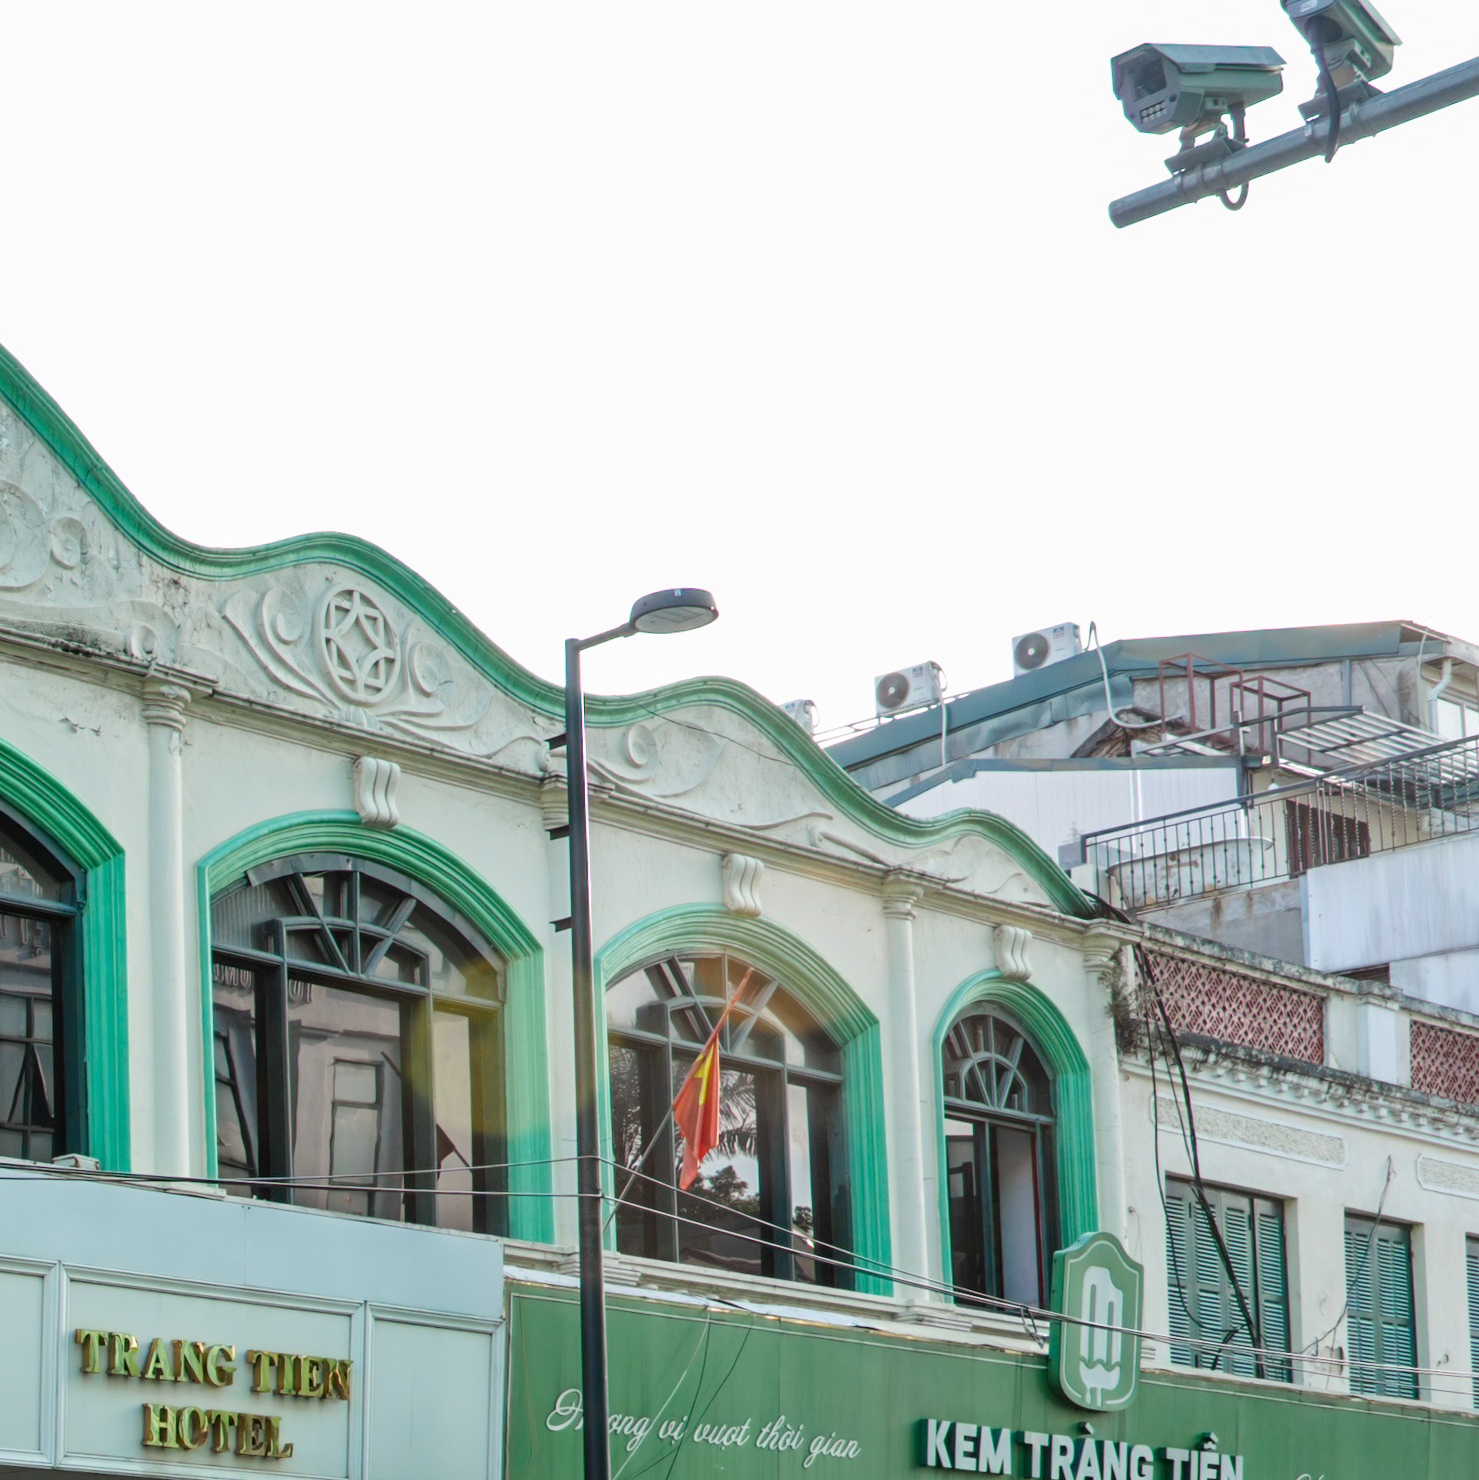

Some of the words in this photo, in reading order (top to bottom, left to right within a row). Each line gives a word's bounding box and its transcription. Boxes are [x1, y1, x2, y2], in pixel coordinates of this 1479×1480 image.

[75, 1328, 236, 1388] TRANG
[245, 1349, 354, 1401] TIEN
[142, 1403, 294, 1459] HOTEL
[546, 1388, 652, 1452] Hơng
[658, 1414, 687, 1445] vị
[693, 1418, 752, 1452] vượt
[755, 1415, 805, 1450] thời
[802, 1431, 861, 1468] gian
[920, 1418, 1012, 1475] KEM
